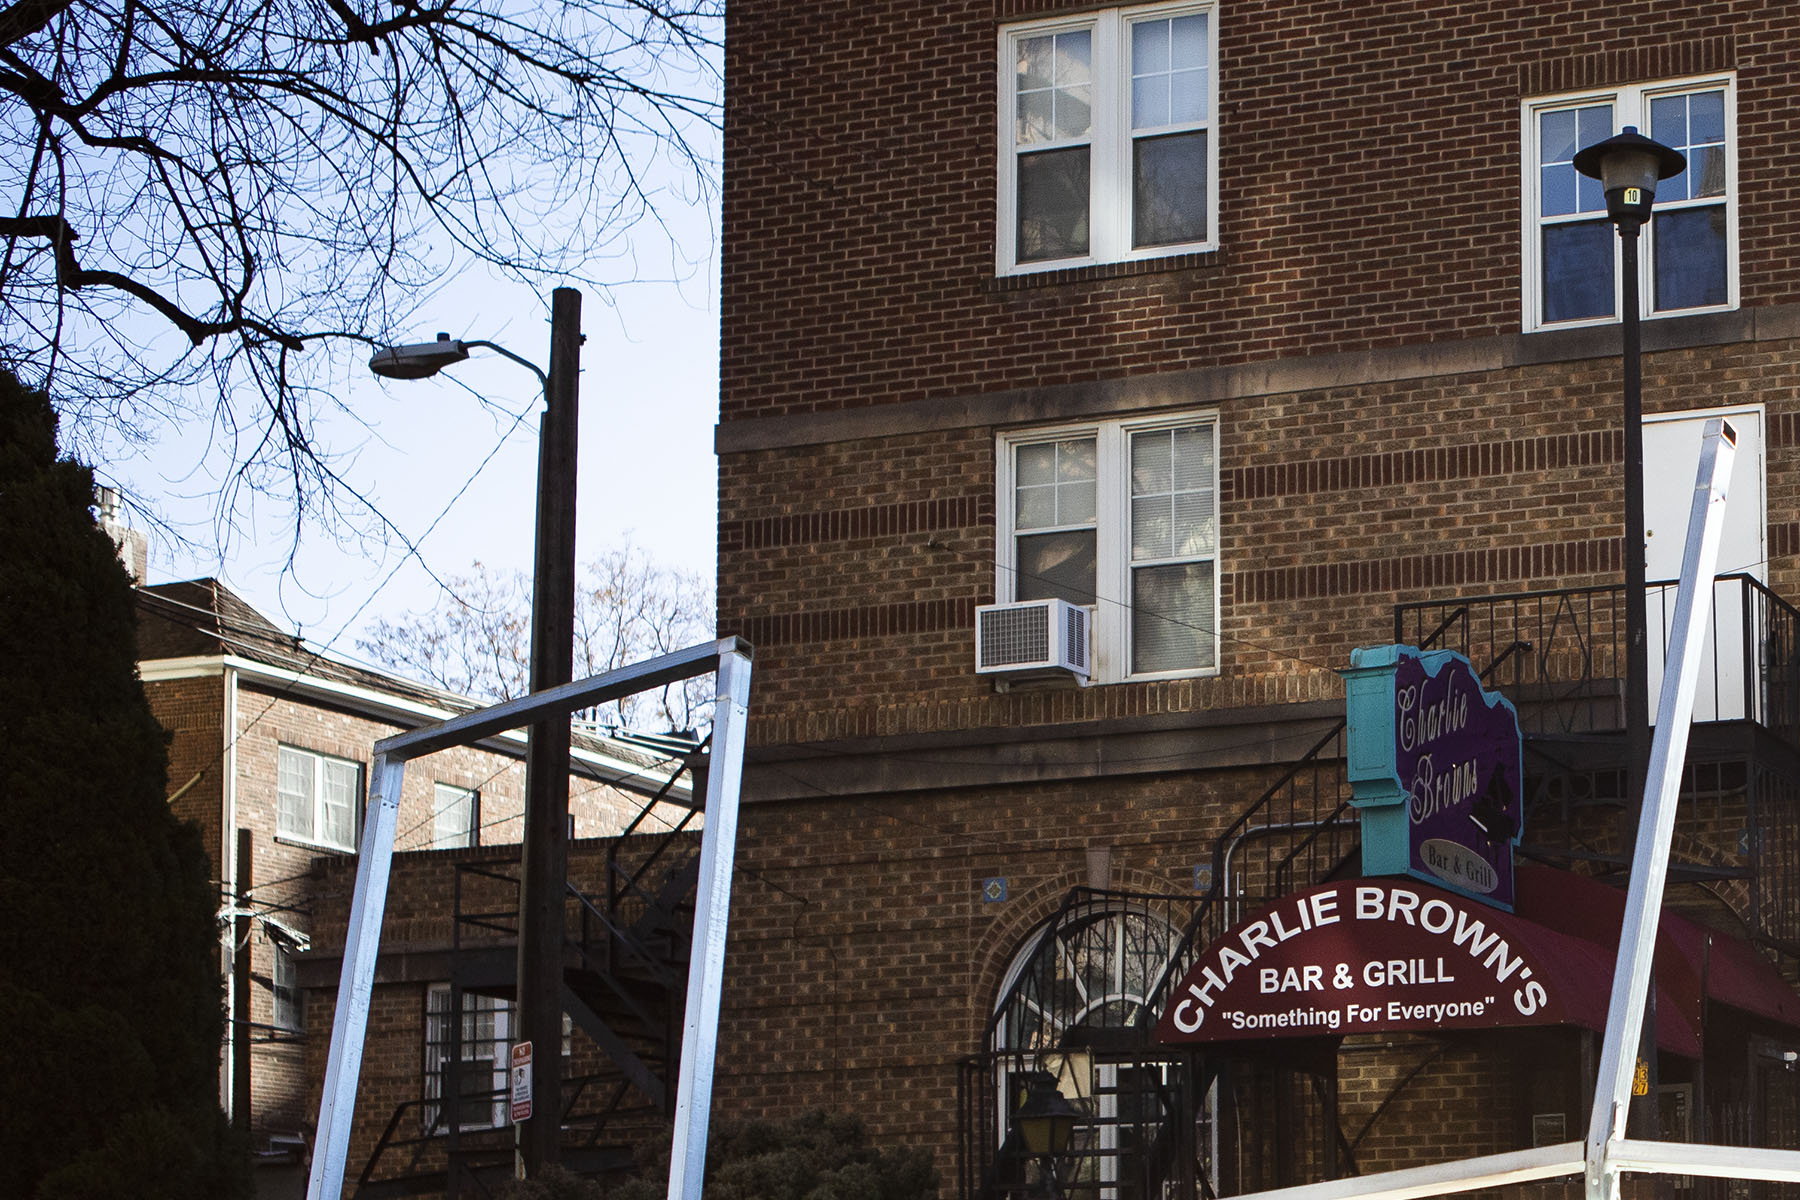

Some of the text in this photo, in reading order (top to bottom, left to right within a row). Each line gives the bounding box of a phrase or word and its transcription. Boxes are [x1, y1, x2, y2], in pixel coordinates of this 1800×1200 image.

[1628, 190, 1637, 202] 10
[1398, 669, 1467, 752] Charlie
[1409, 753, 1477, 824] Browns
[1428, 845, 1492, 888] Bar & Grill
[1173, 887, 1547, 1033] CHARLIE BROWN'S
[1261, 958, 1454, 993] BAR & GRILL
[1223, 997, 1494, 1028] "Something For Everyone"
[1633, 1083, 1647, 1094] 27
